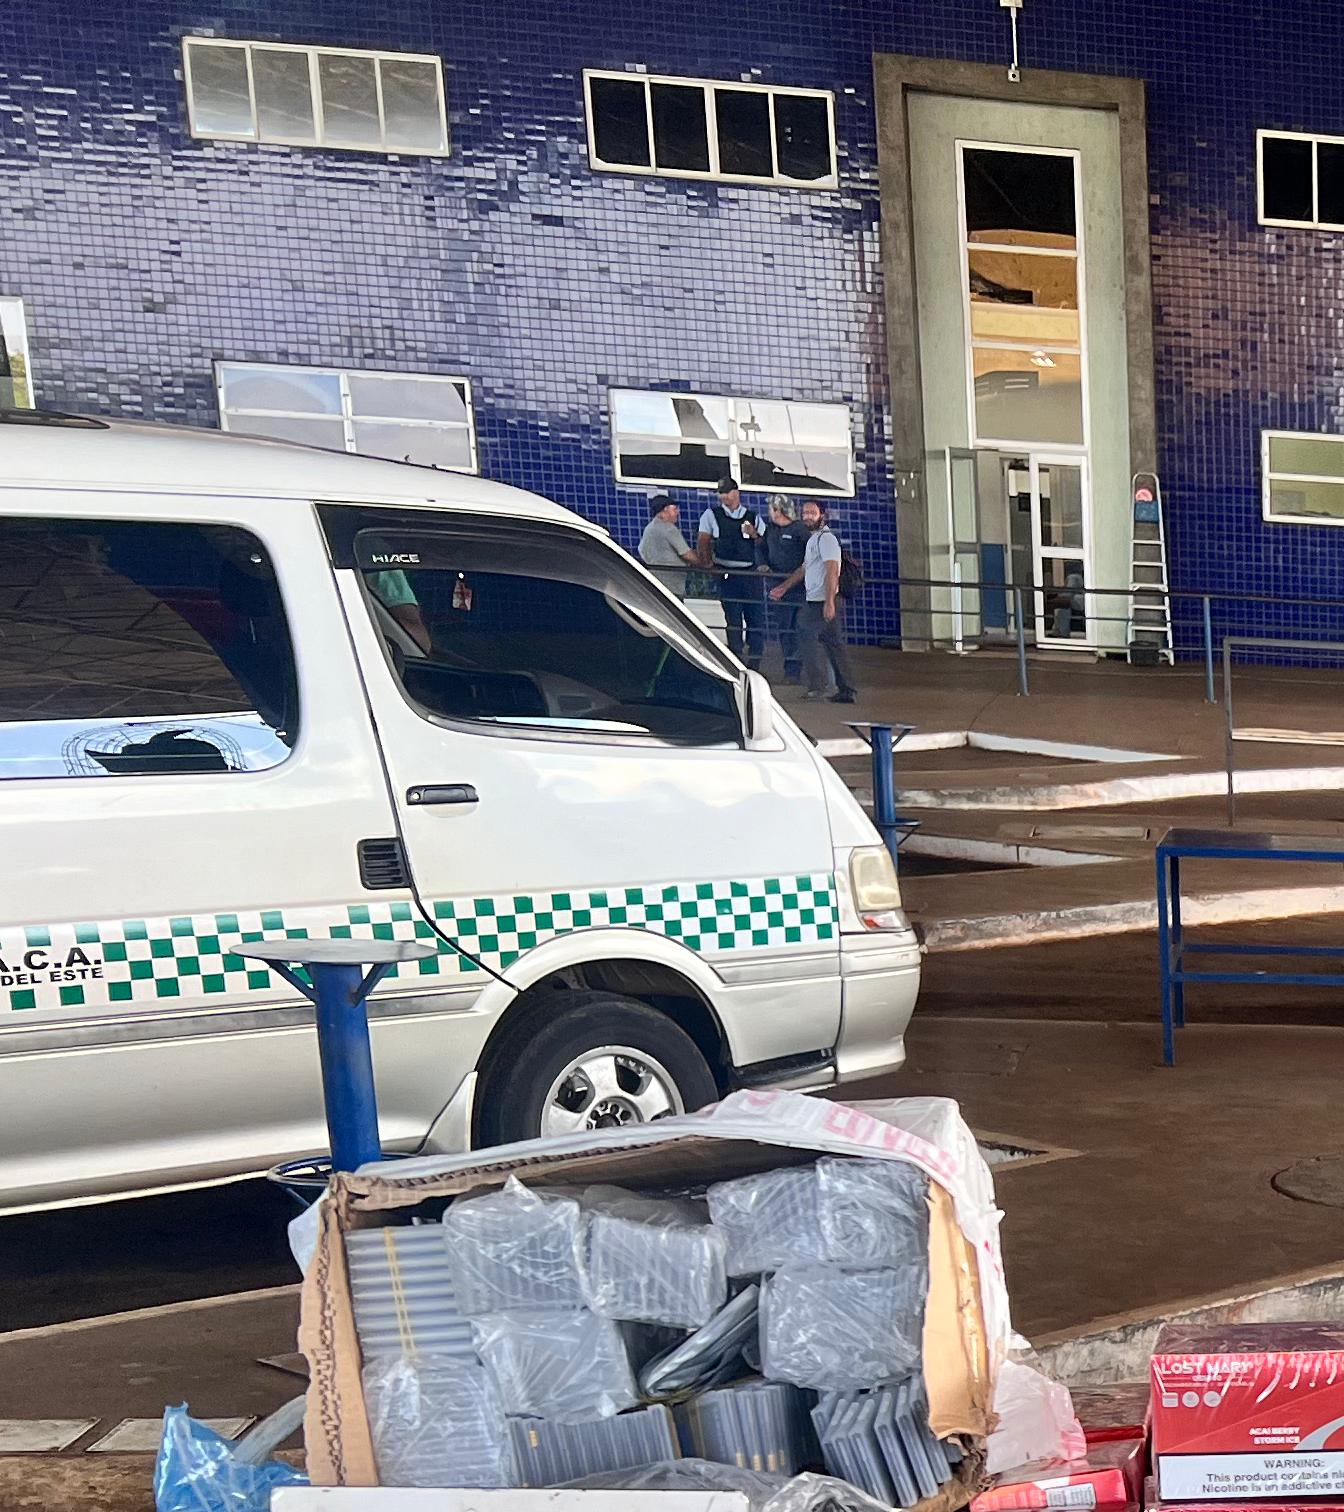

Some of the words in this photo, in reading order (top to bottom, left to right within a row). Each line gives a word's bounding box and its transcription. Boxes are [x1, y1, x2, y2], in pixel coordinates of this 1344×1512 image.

[372, 554, 420, 563] HIACE
[1, 973, 42, 986] DEL
[49, 967, 104, 982] ESTE
[1161, 1361, 1204, 1374] LOST
[1264, 1459, 1325, 1469] WARNING:
[1207, 1473, 1230, 1482] This
[1234, 1473, 1277, 1483] product
[1202, 1484, 1249, 1493] Nicotine
[1251, 1483, 1261, 1491] is
[1281, 1481, 1331, 1490] addictive
